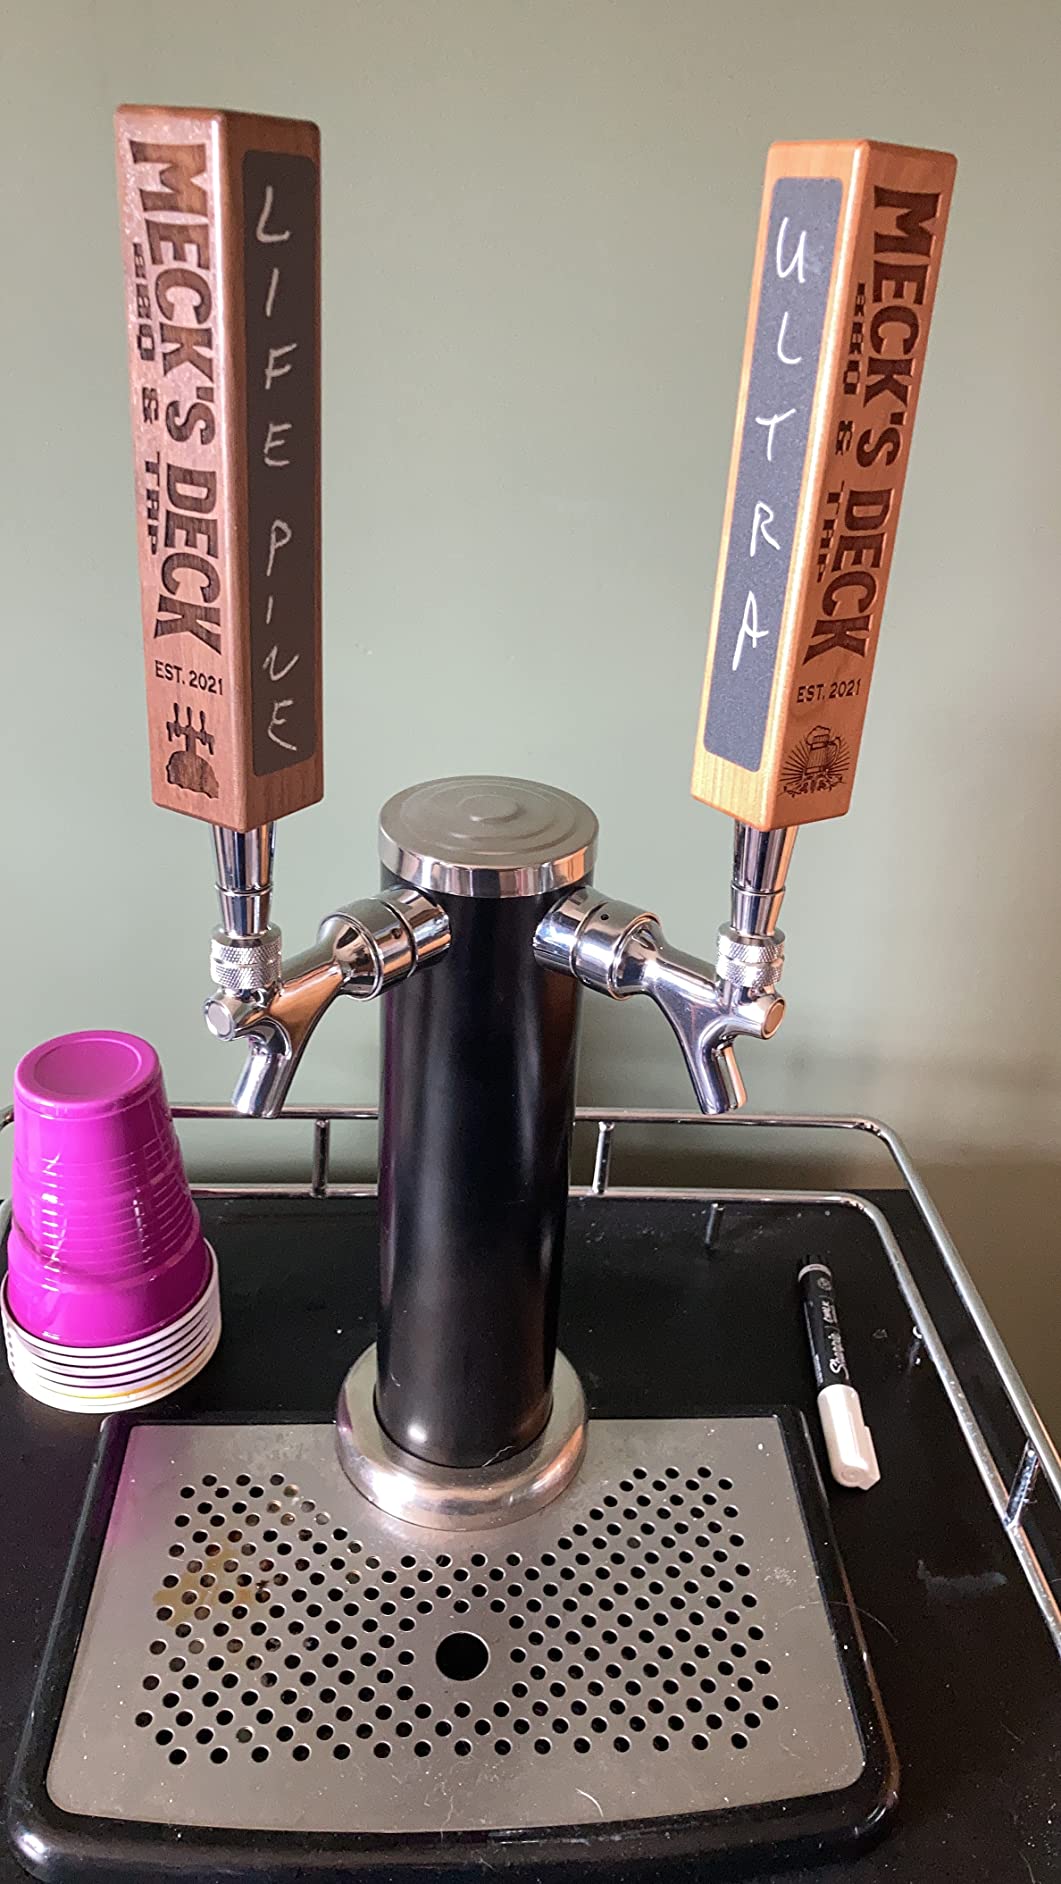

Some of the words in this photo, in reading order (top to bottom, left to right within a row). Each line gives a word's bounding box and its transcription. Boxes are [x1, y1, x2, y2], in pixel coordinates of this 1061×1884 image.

[130, 140, 216, 446] MECK'S
[132, 242, 156, 362] BBQ
[255, 185, 298, 467] LIFE
[843, 282, 866, 396] BBQ
[856, 185, 943, 469] MECK'S
[142, 386, 159, 424] &
[732, 216, 808, 672] ULTRA
[835, 419, 854, 456] &
[145, 451, 159, 555] TAP
[154, 463, 222, 656] DECK
[816, 480, 846, 584] TAP
[262, 518, 300, 752] PINE
[802, 487, 895, 667] DECK
[155, 659, 186, 686] EST.
[189, 669, 224, 696] 2021
[796, 684, 826, 704] EST.
[829, 677, 862, 701] 2021
[827, 1331, 849, 1380] Sharpie
